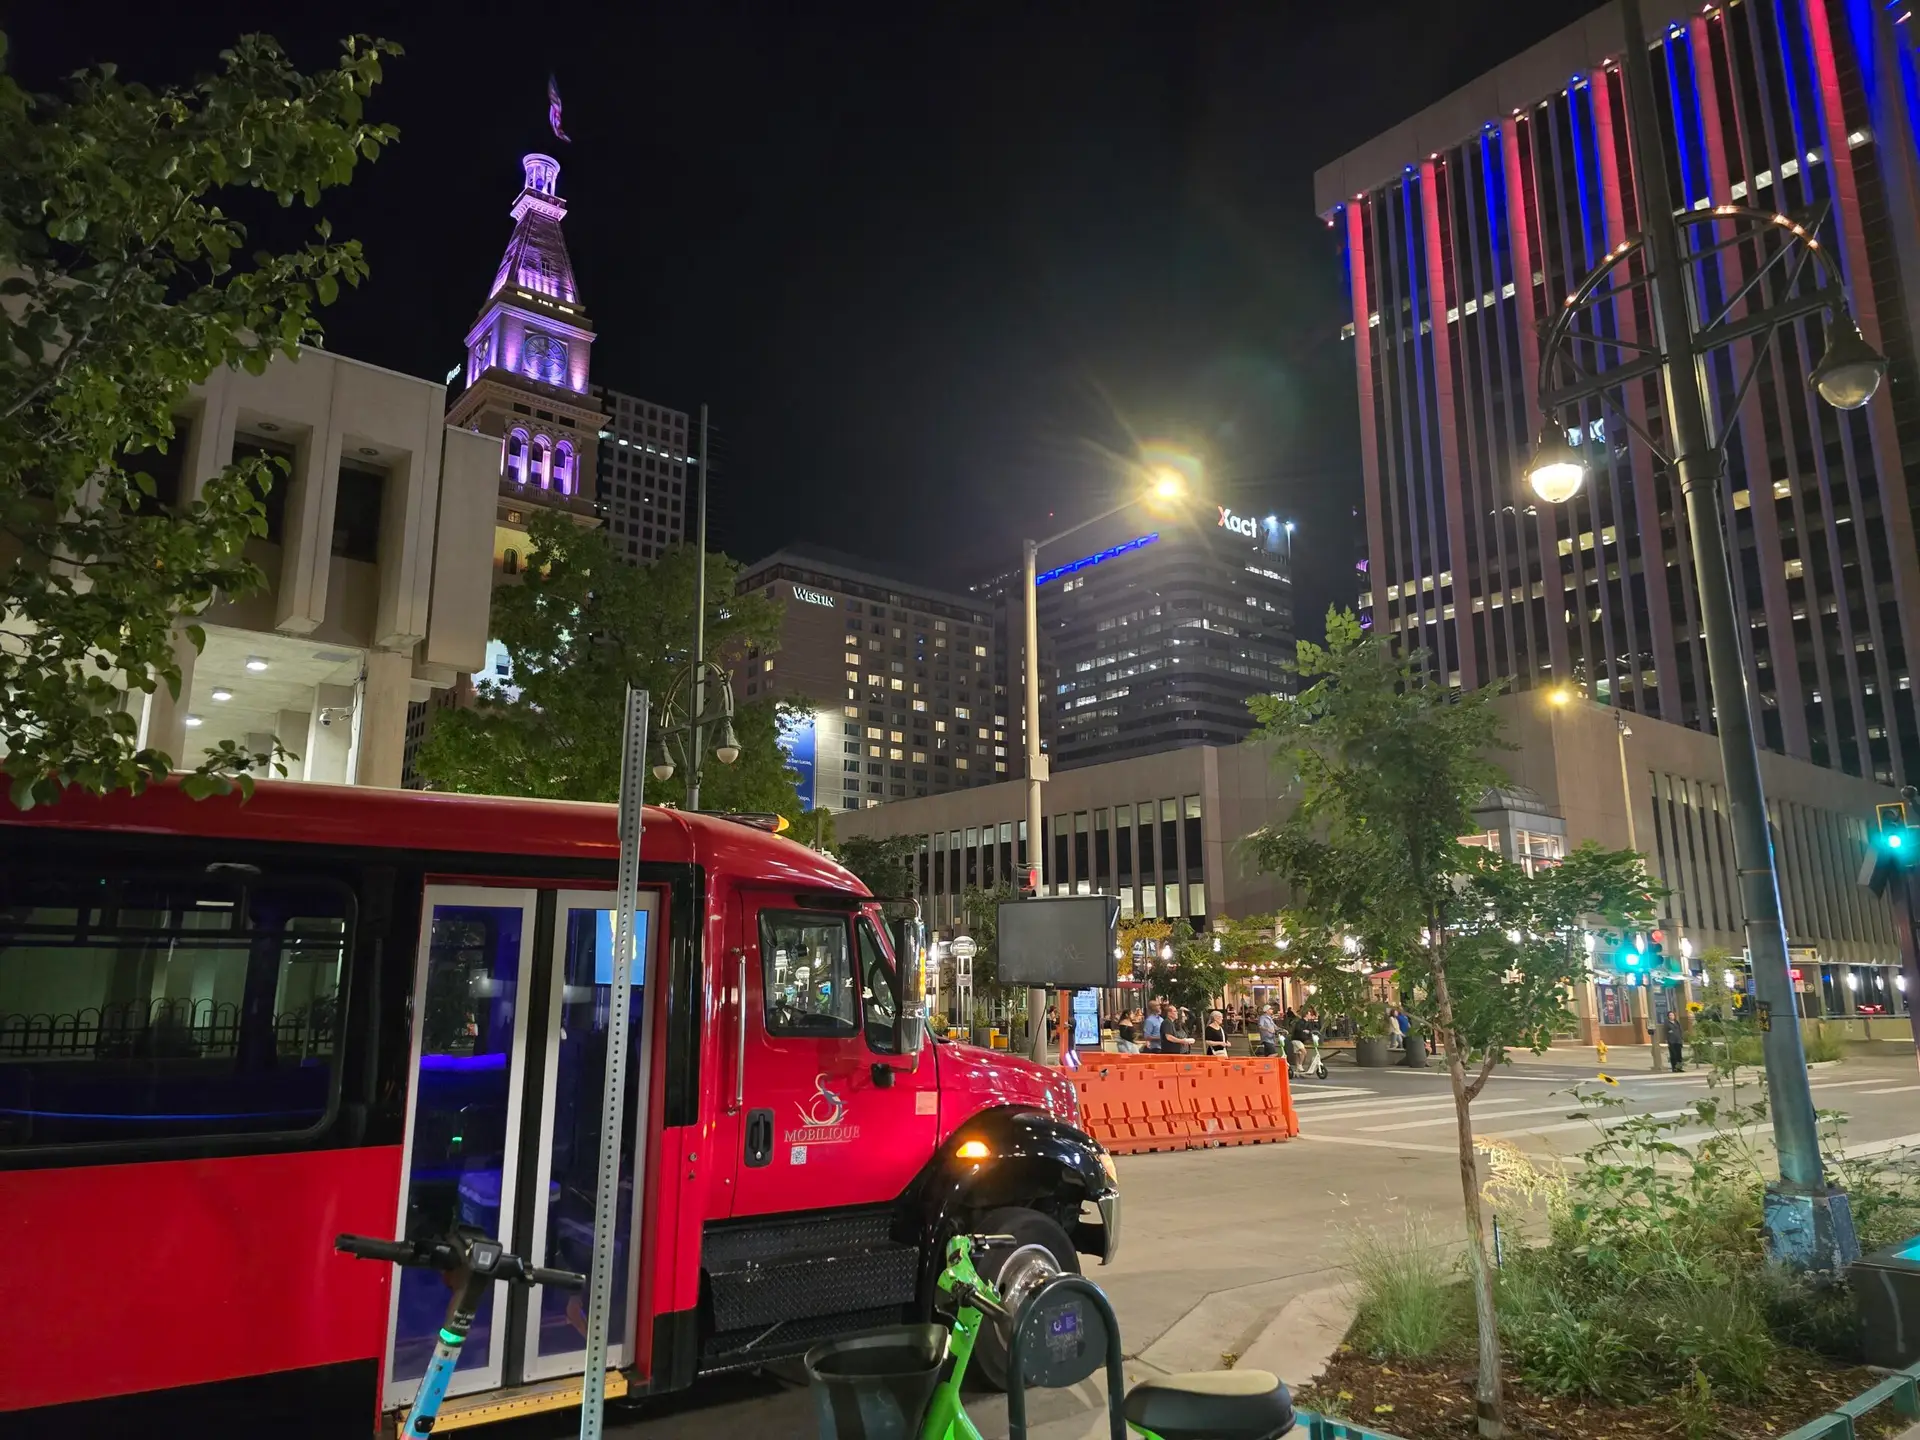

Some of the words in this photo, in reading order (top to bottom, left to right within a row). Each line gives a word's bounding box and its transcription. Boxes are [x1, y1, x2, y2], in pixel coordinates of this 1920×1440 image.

[1217, 505, 1257, 538] Xact
[793, 586, 835, 608] WESTIN
[783, 1125, 861, 1143] MOBILIQUE
